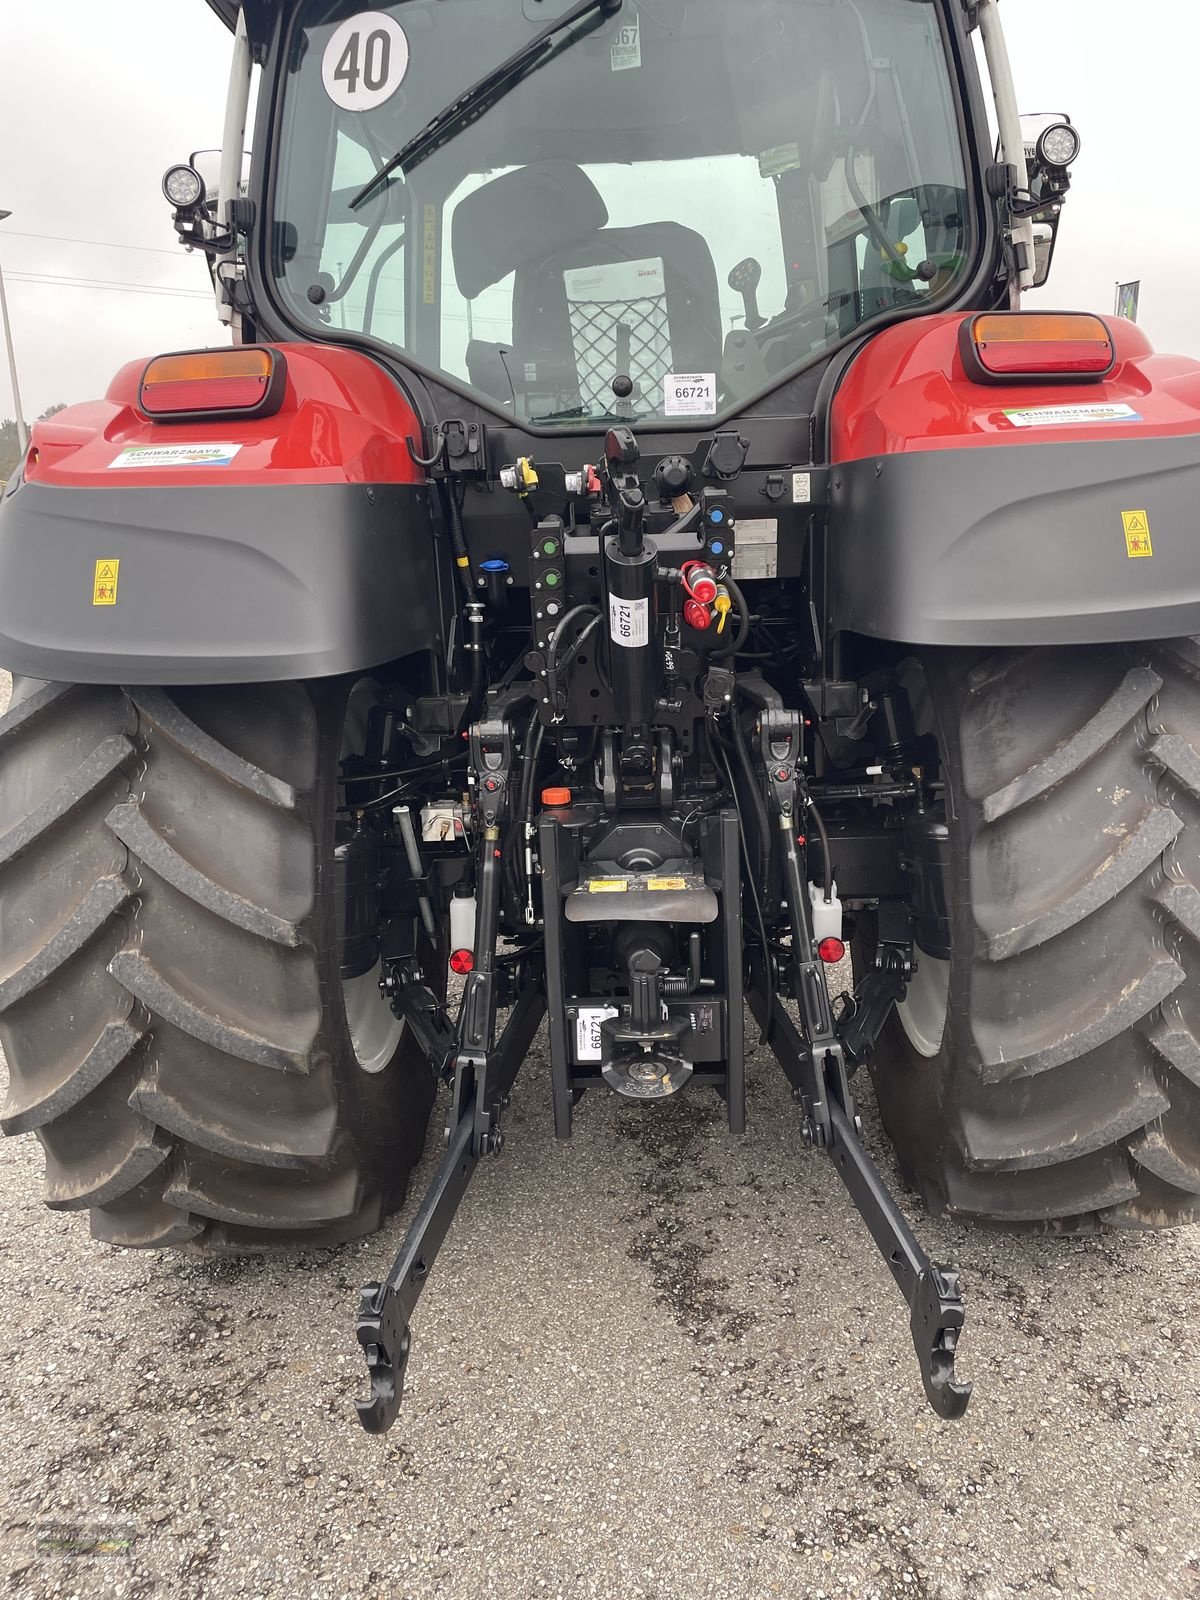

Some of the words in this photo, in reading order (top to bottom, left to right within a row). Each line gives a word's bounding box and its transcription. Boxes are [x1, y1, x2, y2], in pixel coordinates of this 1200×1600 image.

[334, 29, 391, 93] 40
[675, 387, 709, 398] 66721
[1016, 407, 1115, 418] SCHWARZMAYR
[128, 449, 221, 457] SCHWARZMAYR
[620, 605, 631, 638] 66721
[591, 1015, 602, 1049] 66721
